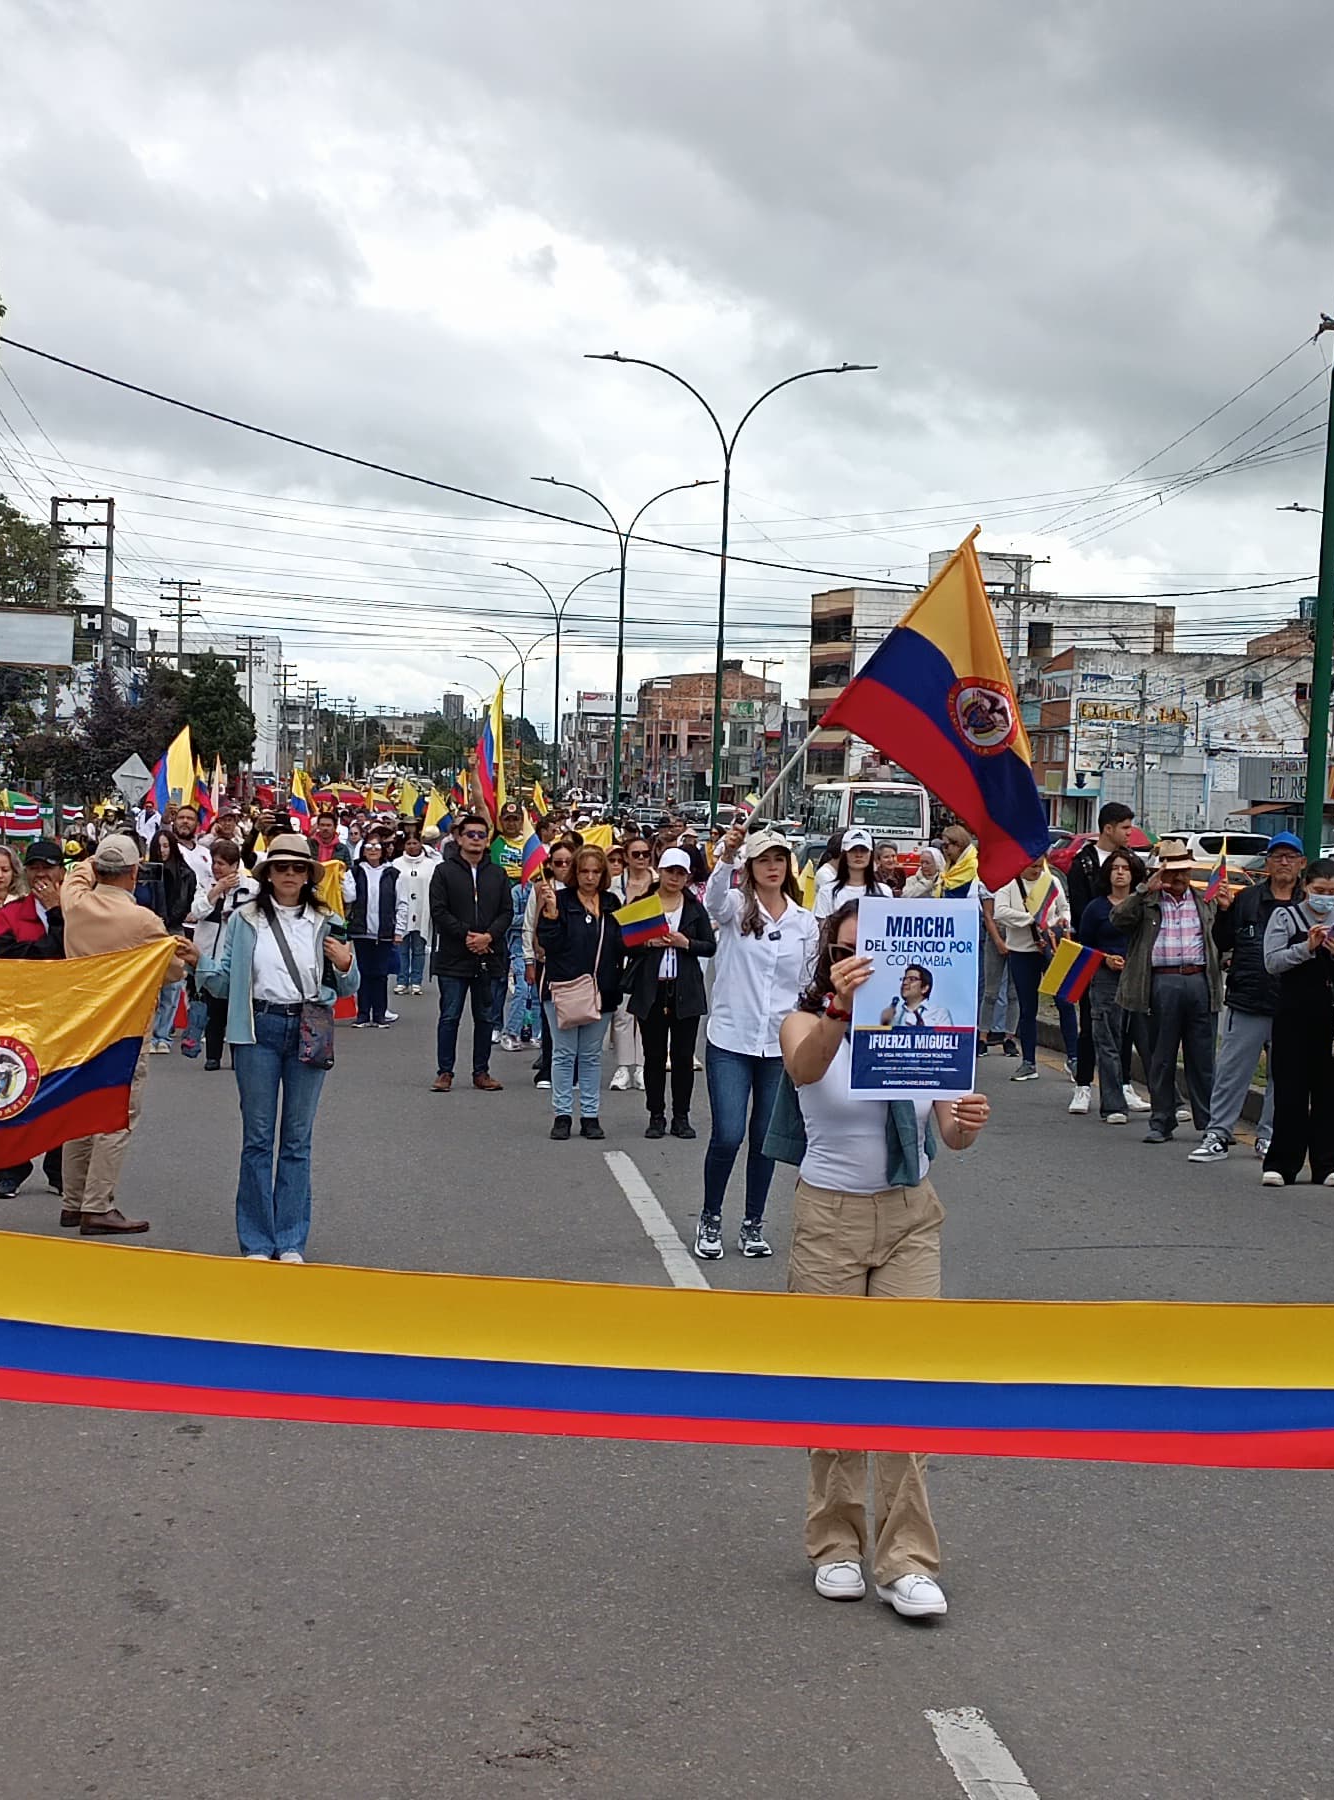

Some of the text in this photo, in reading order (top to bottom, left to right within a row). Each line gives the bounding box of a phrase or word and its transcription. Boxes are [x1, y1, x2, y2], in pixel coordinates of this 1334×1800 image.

[1270, 776, 1285, 799] EL
[886, 916, 955, 938] MARCHA
[865, 939, 973, 954] DEL SILENCIO POR
[886, 954, 953, 967] COLOMBIA
[868, 1034, 959, 1050] ¡FUERZA MIGUEL!
